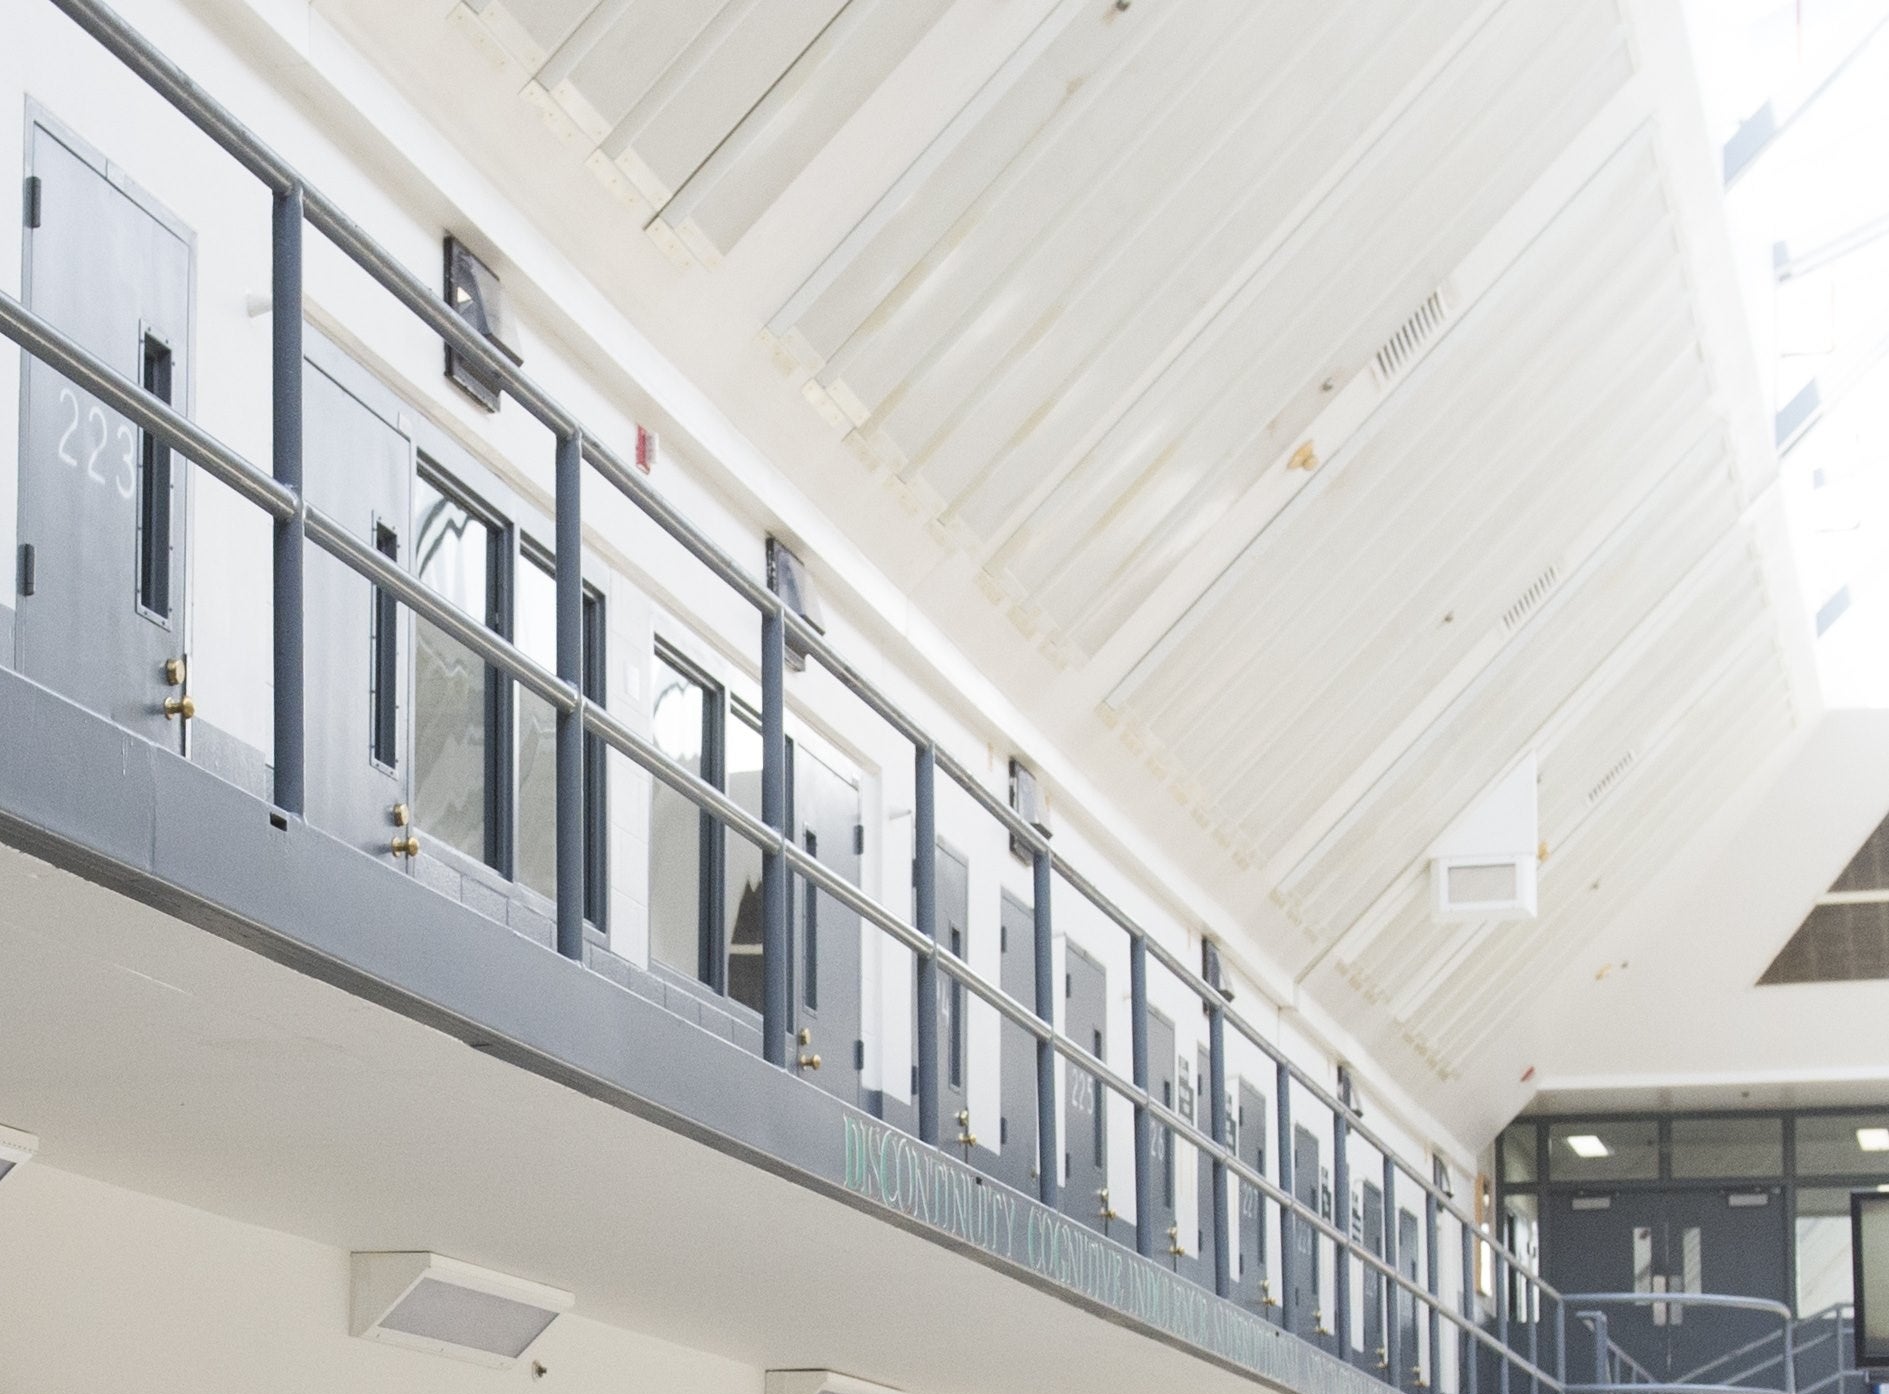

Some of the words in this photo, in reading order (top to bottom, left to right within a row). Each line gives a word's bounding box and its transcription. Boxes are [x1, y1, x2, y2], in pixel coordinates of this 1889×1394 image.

[57, 386, 137, 500] 223
[1072, 1067, 1094, 1115] 225
[842, 1112, 1015, 1257] DISCONTINUITY
